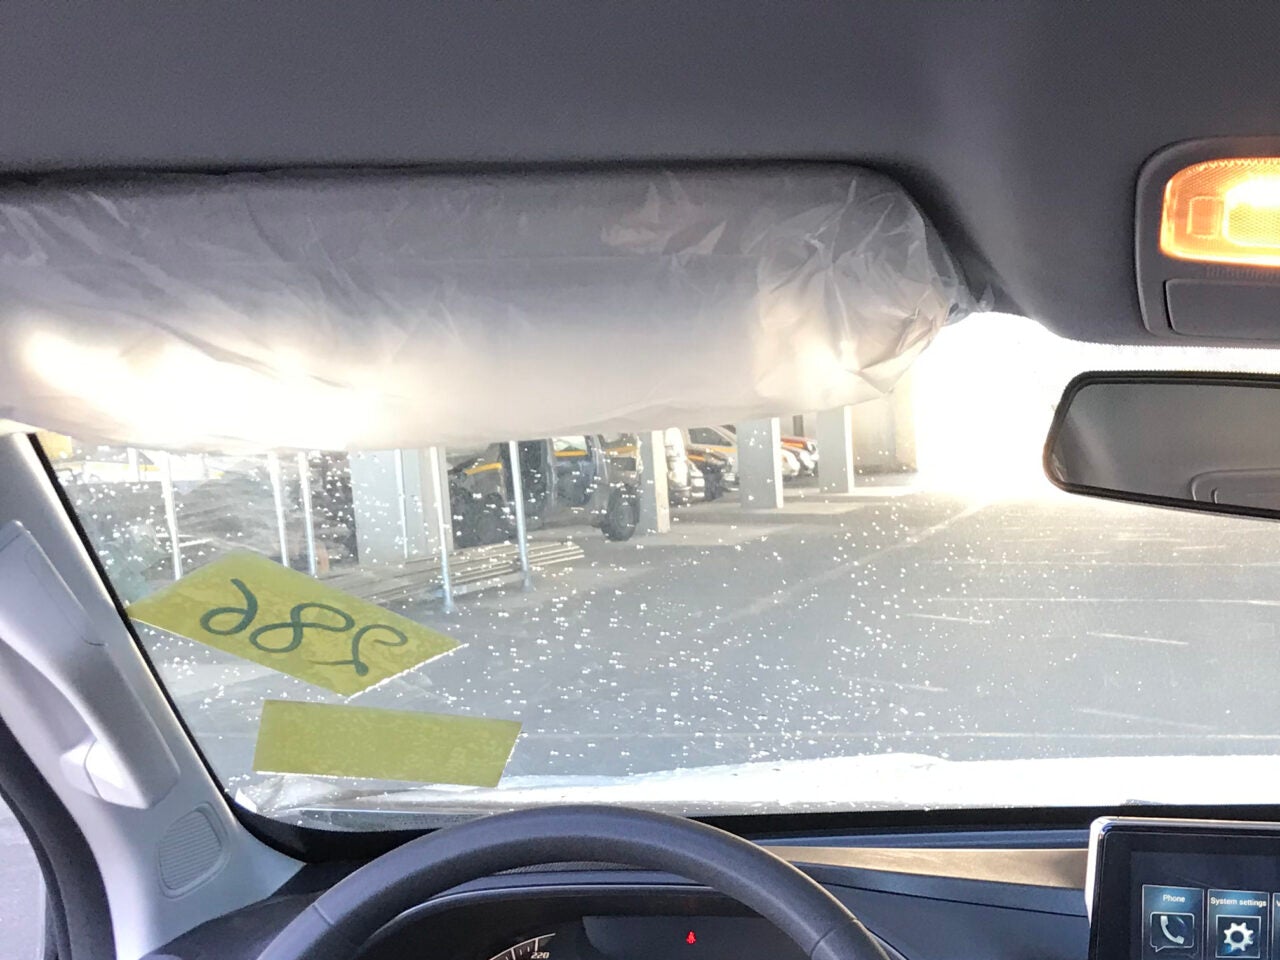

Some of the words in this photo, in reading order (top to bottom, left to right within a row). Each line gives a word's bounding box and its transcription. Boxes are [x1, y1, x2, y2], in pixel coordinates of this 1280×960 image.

[1163, 894, 1186, 903] Phone
[1210, 896, 1238, 906] System
[1239, 898, 1267, 908] settings
[531, 951, 550, 959] 220
